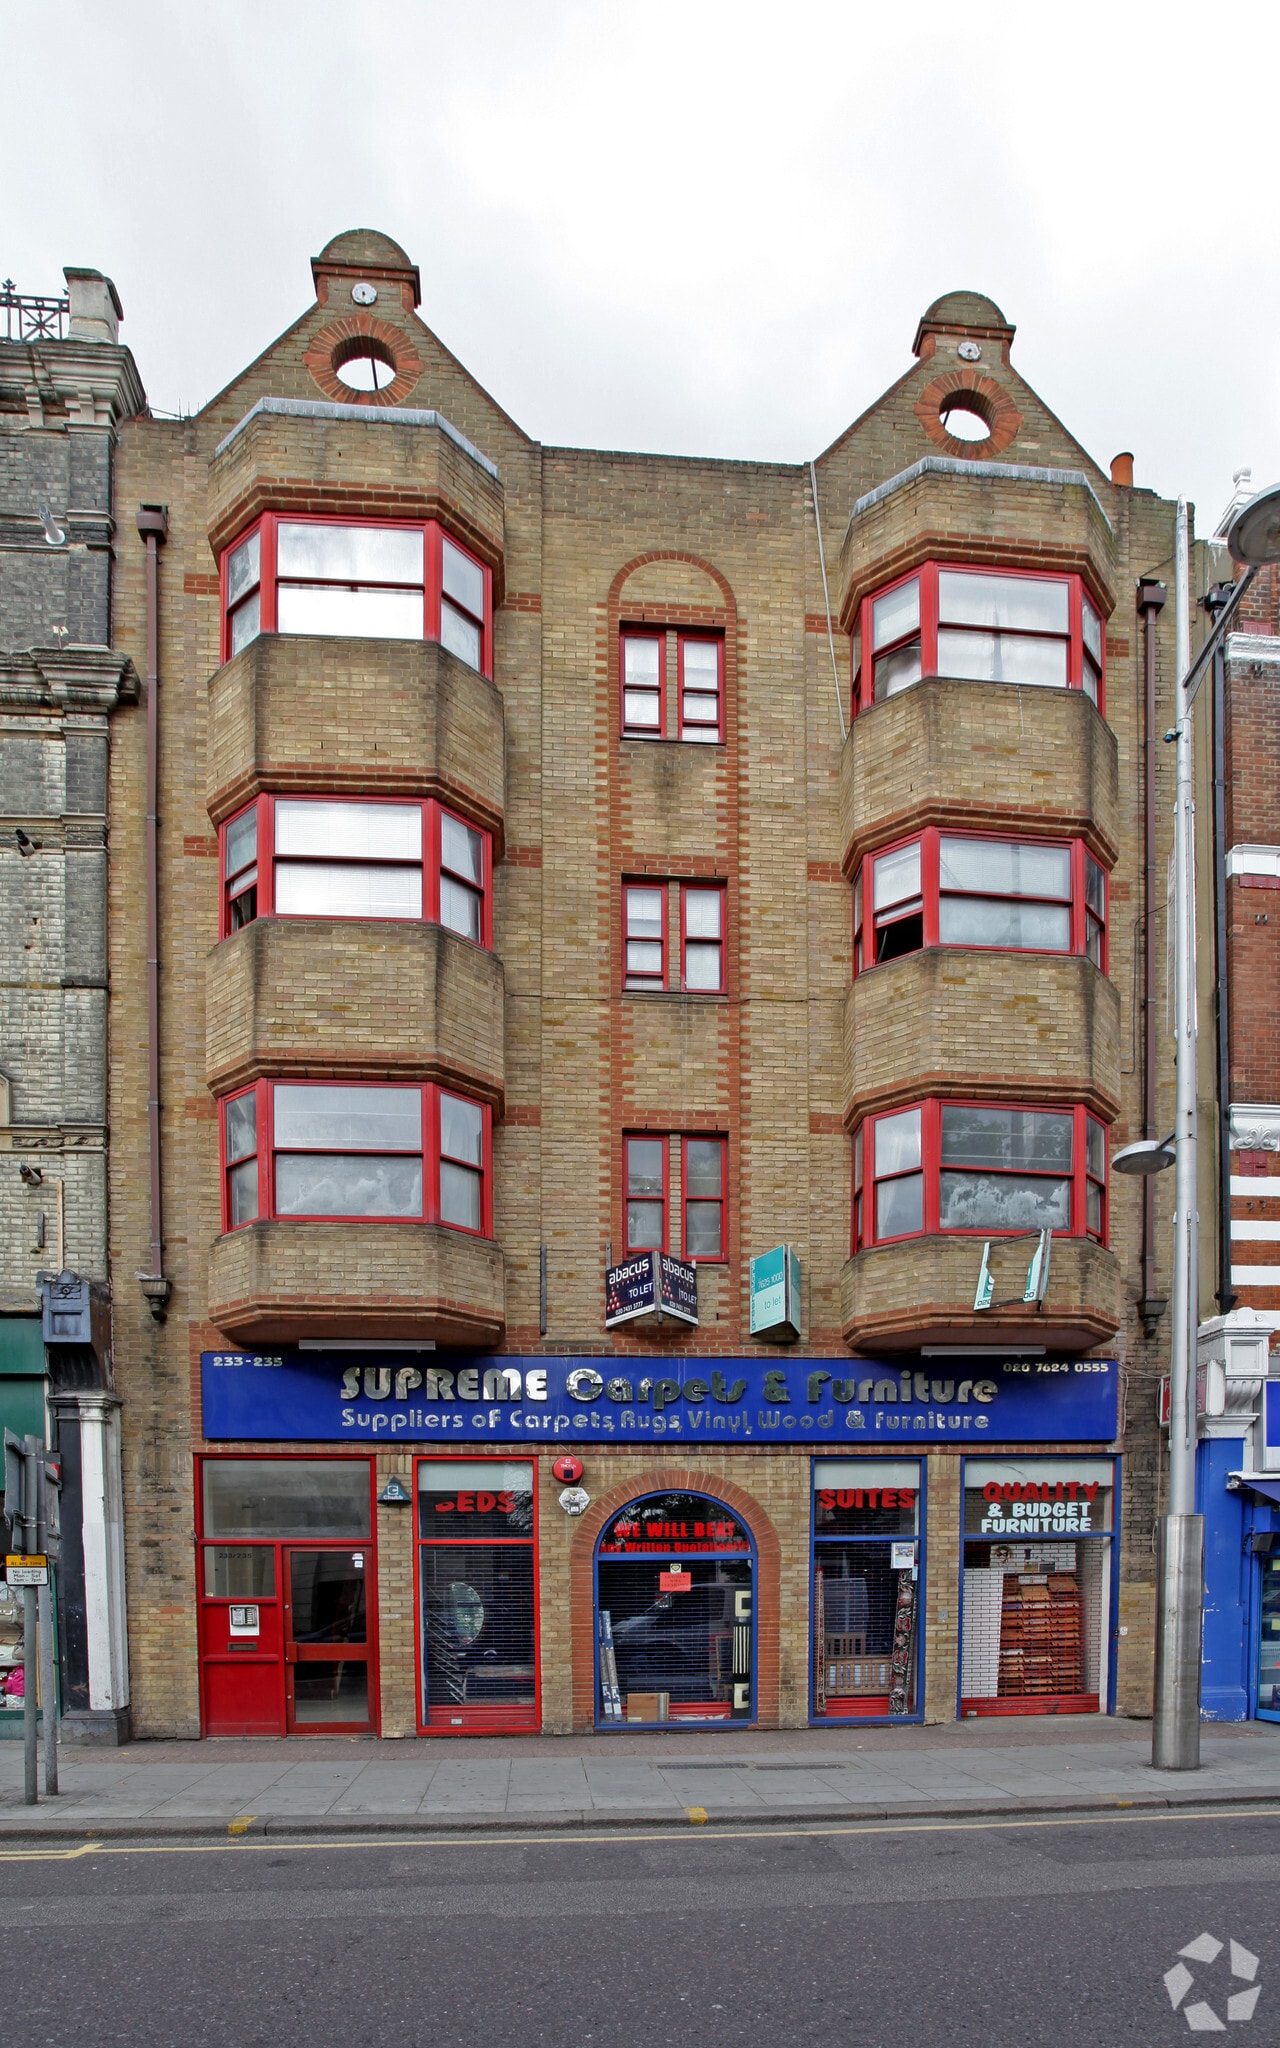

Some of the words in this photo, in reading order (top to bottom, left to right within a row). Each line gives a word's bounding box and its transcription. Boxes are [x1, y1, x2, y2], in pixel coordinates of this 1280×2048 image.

[609, 1259, 649, 1284] abacus
[662, 1258, 694, 1283] abacus
[771, 1271, 783, 1283] 1000
[629, 1288, 639, 1298] TO
[639, 1282, 653, 1294] LET
[680, 1290, 688, 1301] TO
[689, 1294, 697, 1304] LET
[764, 1301, 771, 1310] to
[213, 1356, 283, 1367] 233-235
[1003, 1363, 1030, 1373] 020
[1035, 1363, 1069, 1373] 7624
[1074, 1363, 1109, 1373] 0555
[566, 1368, 746, 1410] Carpets
[763, 1370, 791, 1402] &
[341, 1408, 464, 1432] Suppliers
[757, 1410, 834, 1429] Wood
[845, 1410, 866, 1429] &
[819, 1488, 915, 1509] SUITES
[983, 1481, 1100, 1502] QUALITY
[987, 1503, 1003, 1517] &
[1012, 1502, 1091, 1518] BUDGET
[614, 1522, 640, 1537] WE
[646, 1522, 688, 1537] WILL
[694, 1522, 735, 1537] BEAT
[981, 1518, 1092, 1533] FURNITURE
[625, 1542, 671, 1552] Written
